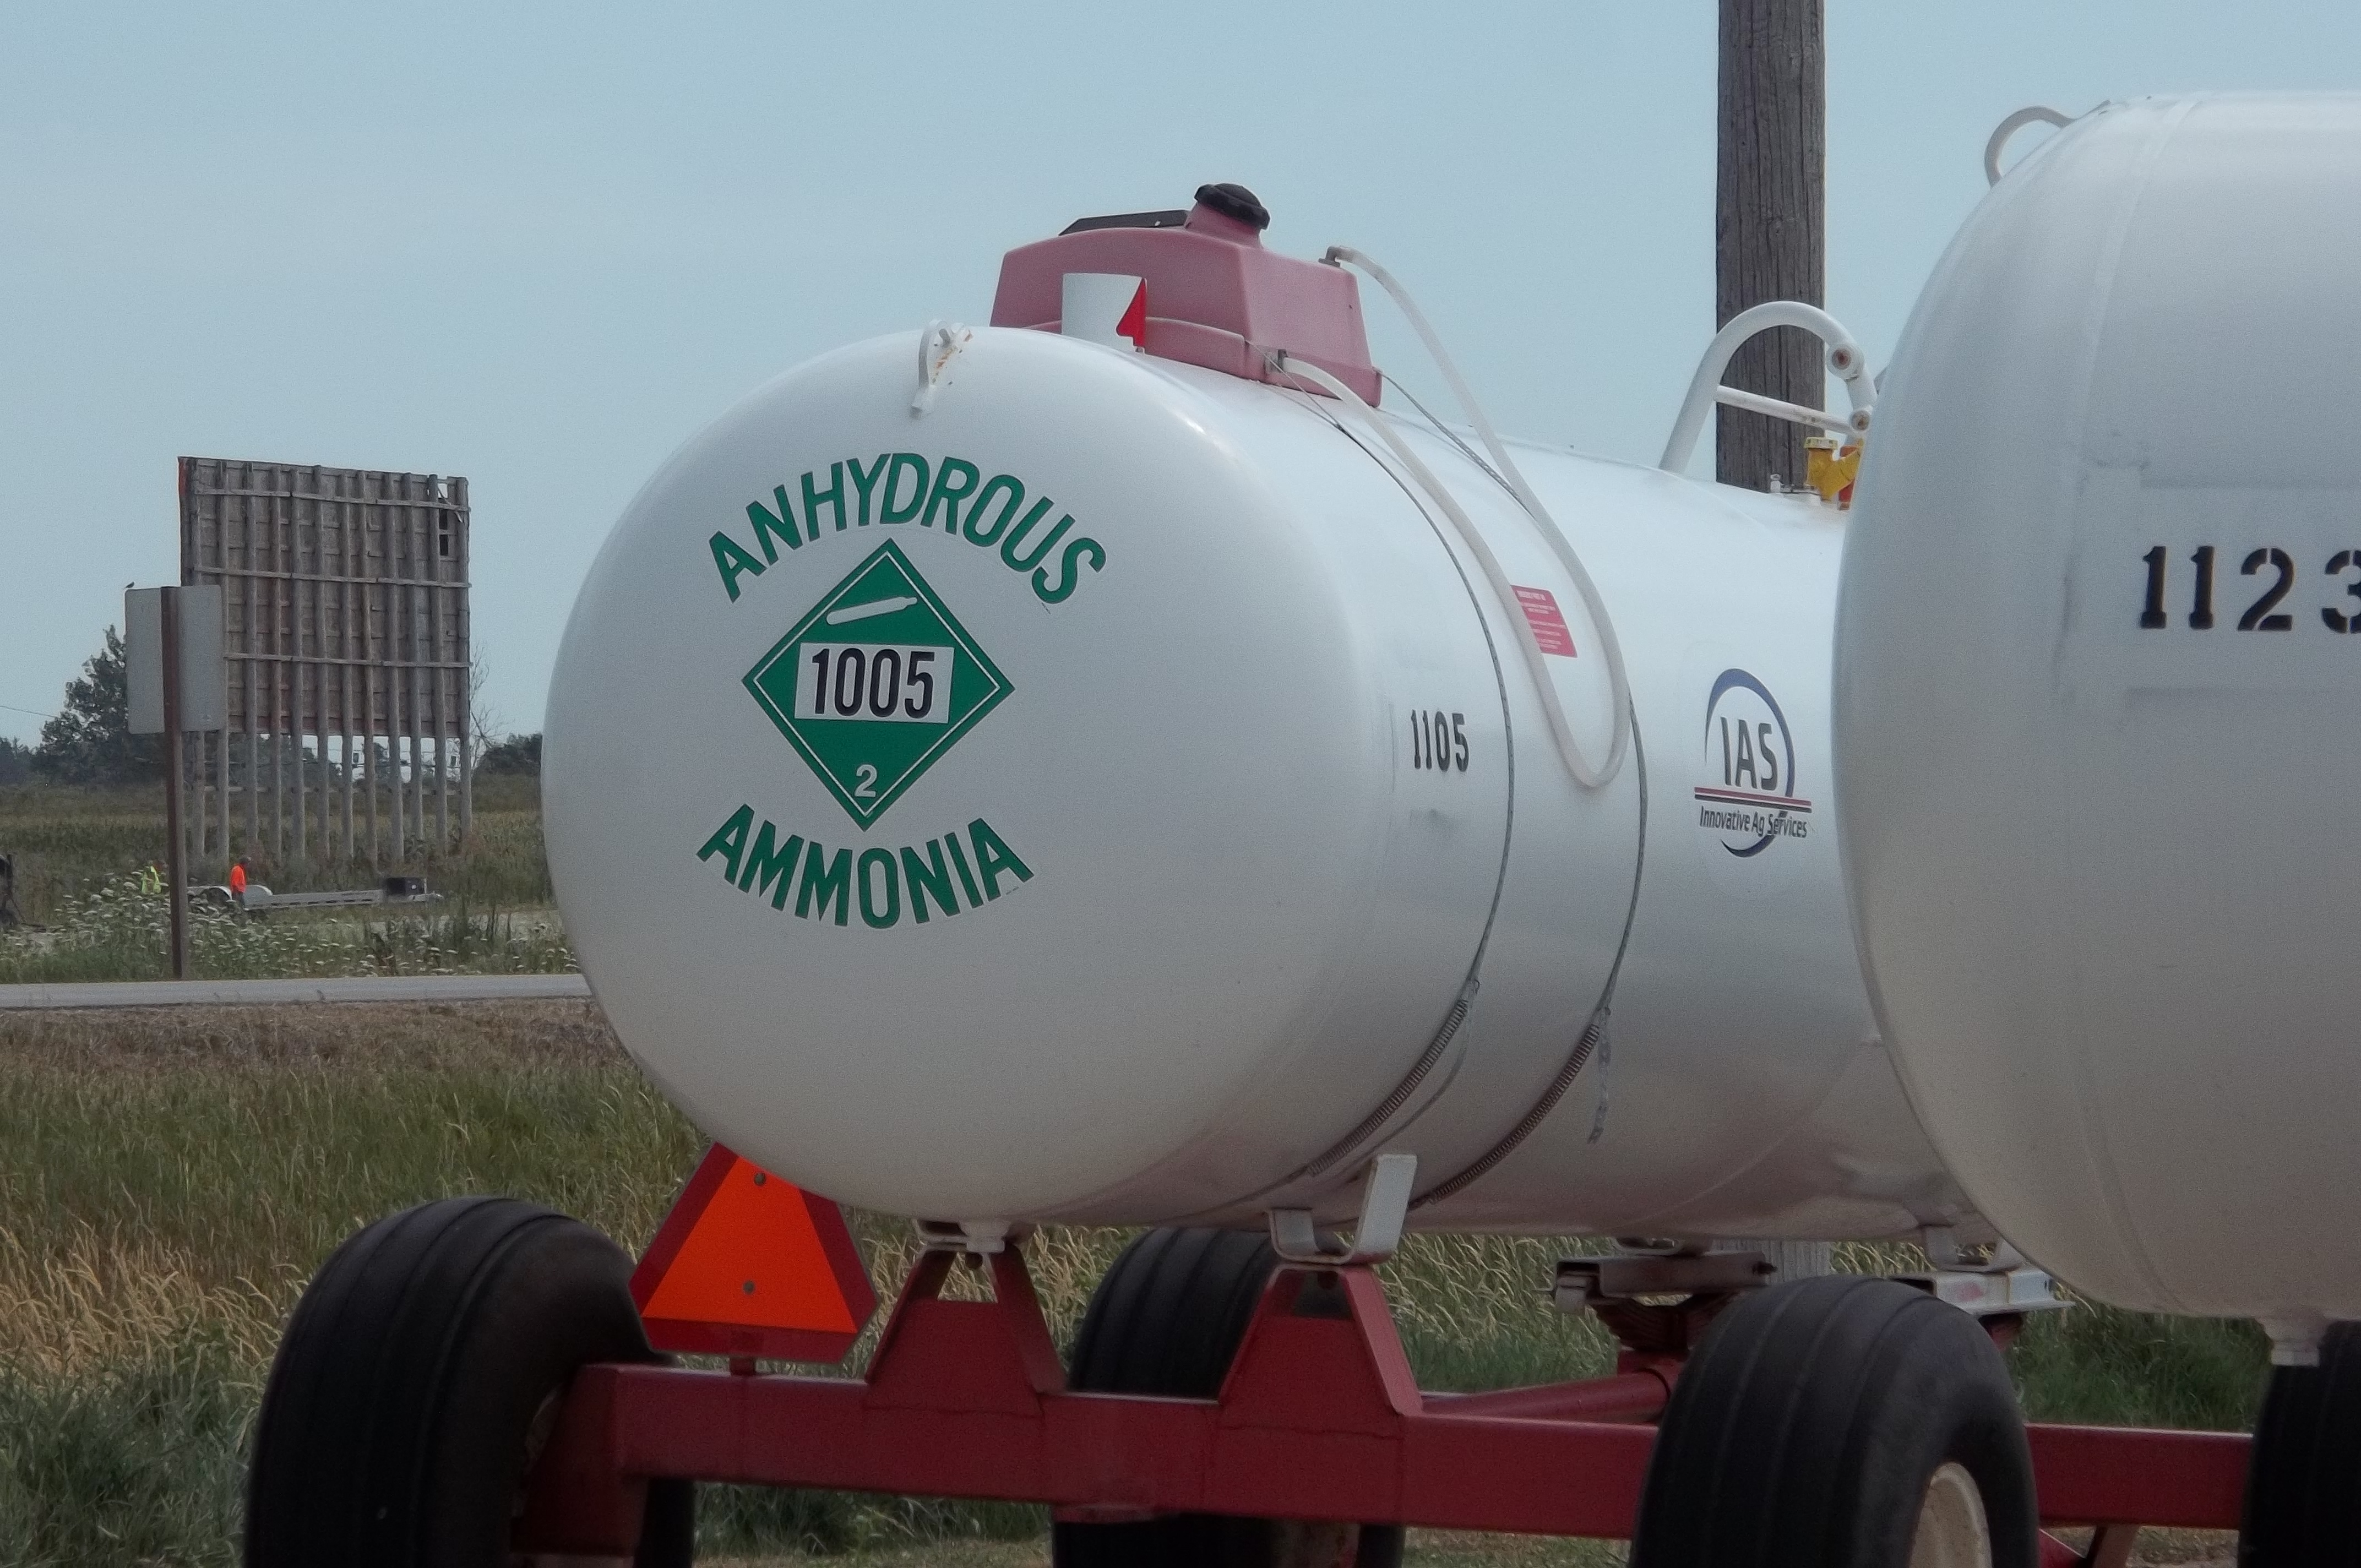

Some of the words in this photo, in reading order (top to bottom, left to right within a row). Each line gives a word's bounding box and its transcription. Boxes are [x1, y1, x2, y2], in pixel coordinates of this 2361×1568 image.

[709, 453, 1106, 605] ANHYDROUS
[812, 647, 935, 719] 1005
[1411, 709, 1469, 772] 1105
[1720, 716, 1778, 791] IAS
[855, 764, 878, 798] 2
[1700, 805, 1750, 832] Innovative
[1751, 811, 1765, 837] Ag
[1767, 813, 1808, 838] Services
[696, 804, 1035, 929] AMMONIA
